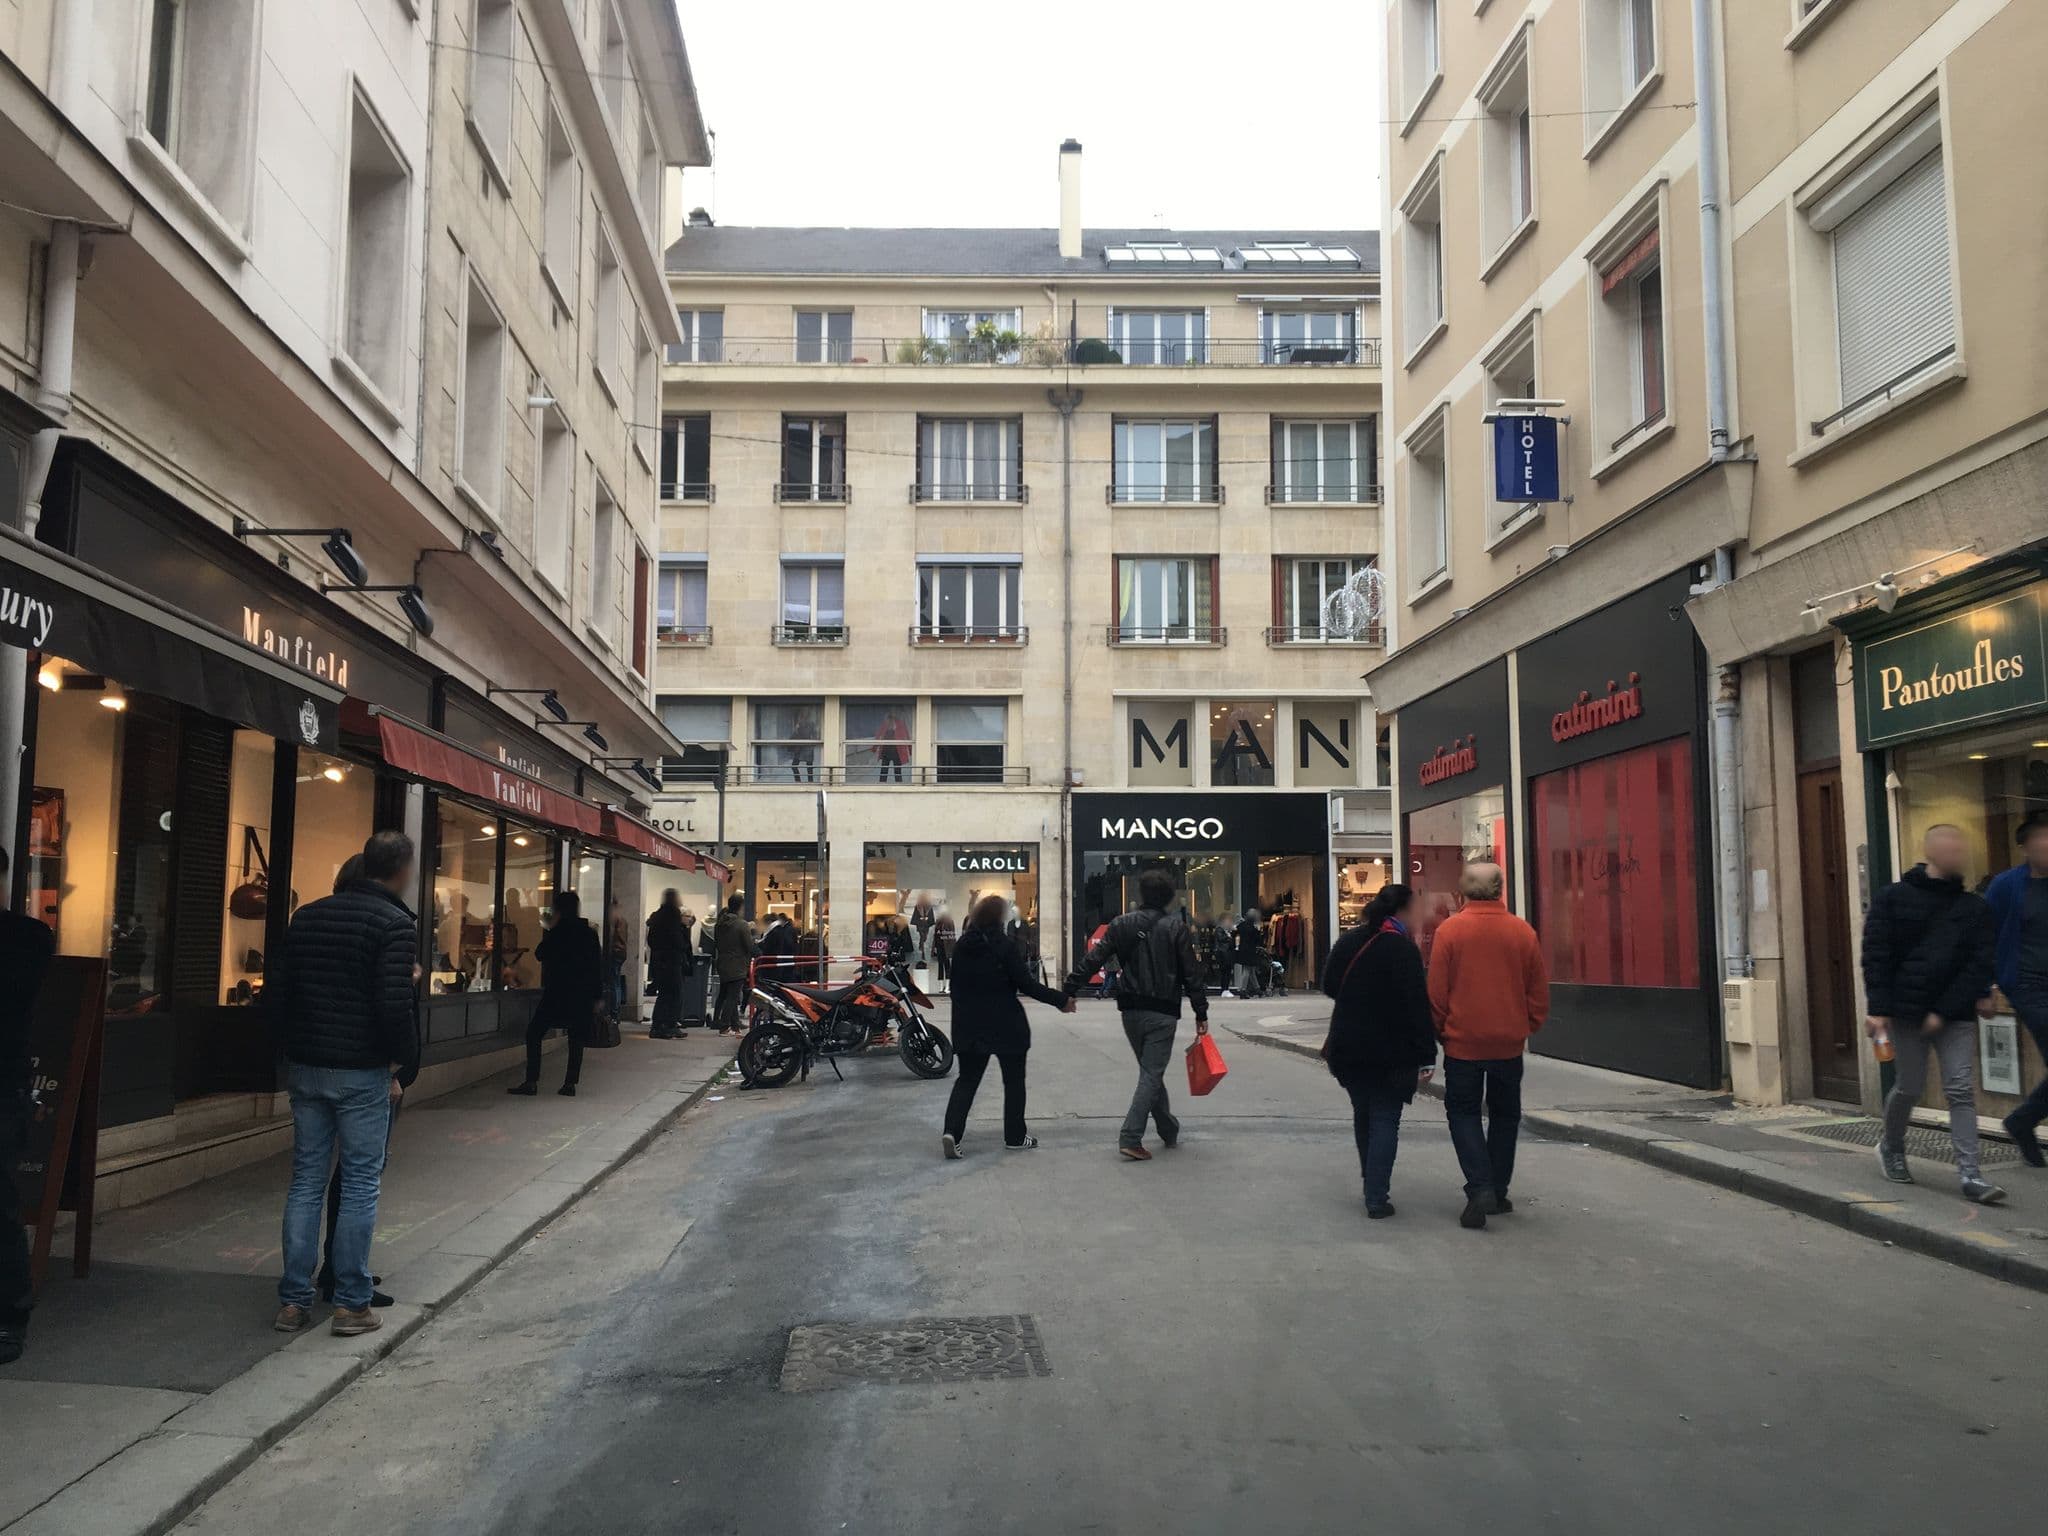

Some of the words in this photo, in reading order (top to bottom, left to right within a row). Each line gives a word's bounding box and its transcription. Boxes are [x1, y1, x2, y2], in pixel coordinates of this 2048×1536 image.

[1521, 419, 1534, 495] HOTEL
[243, 606, 347, 688] Manfield
[1880, 638, 2024, 711] Pantoufles
[1551, 672, 1642, 742] catimini
[1133, 719, 1391, 768] MAN
[1420, 734, 1478, 786] catimini
[1101, 817, 1224, 839] MANGO
[957, 857, 1025, 870] CAROLL
